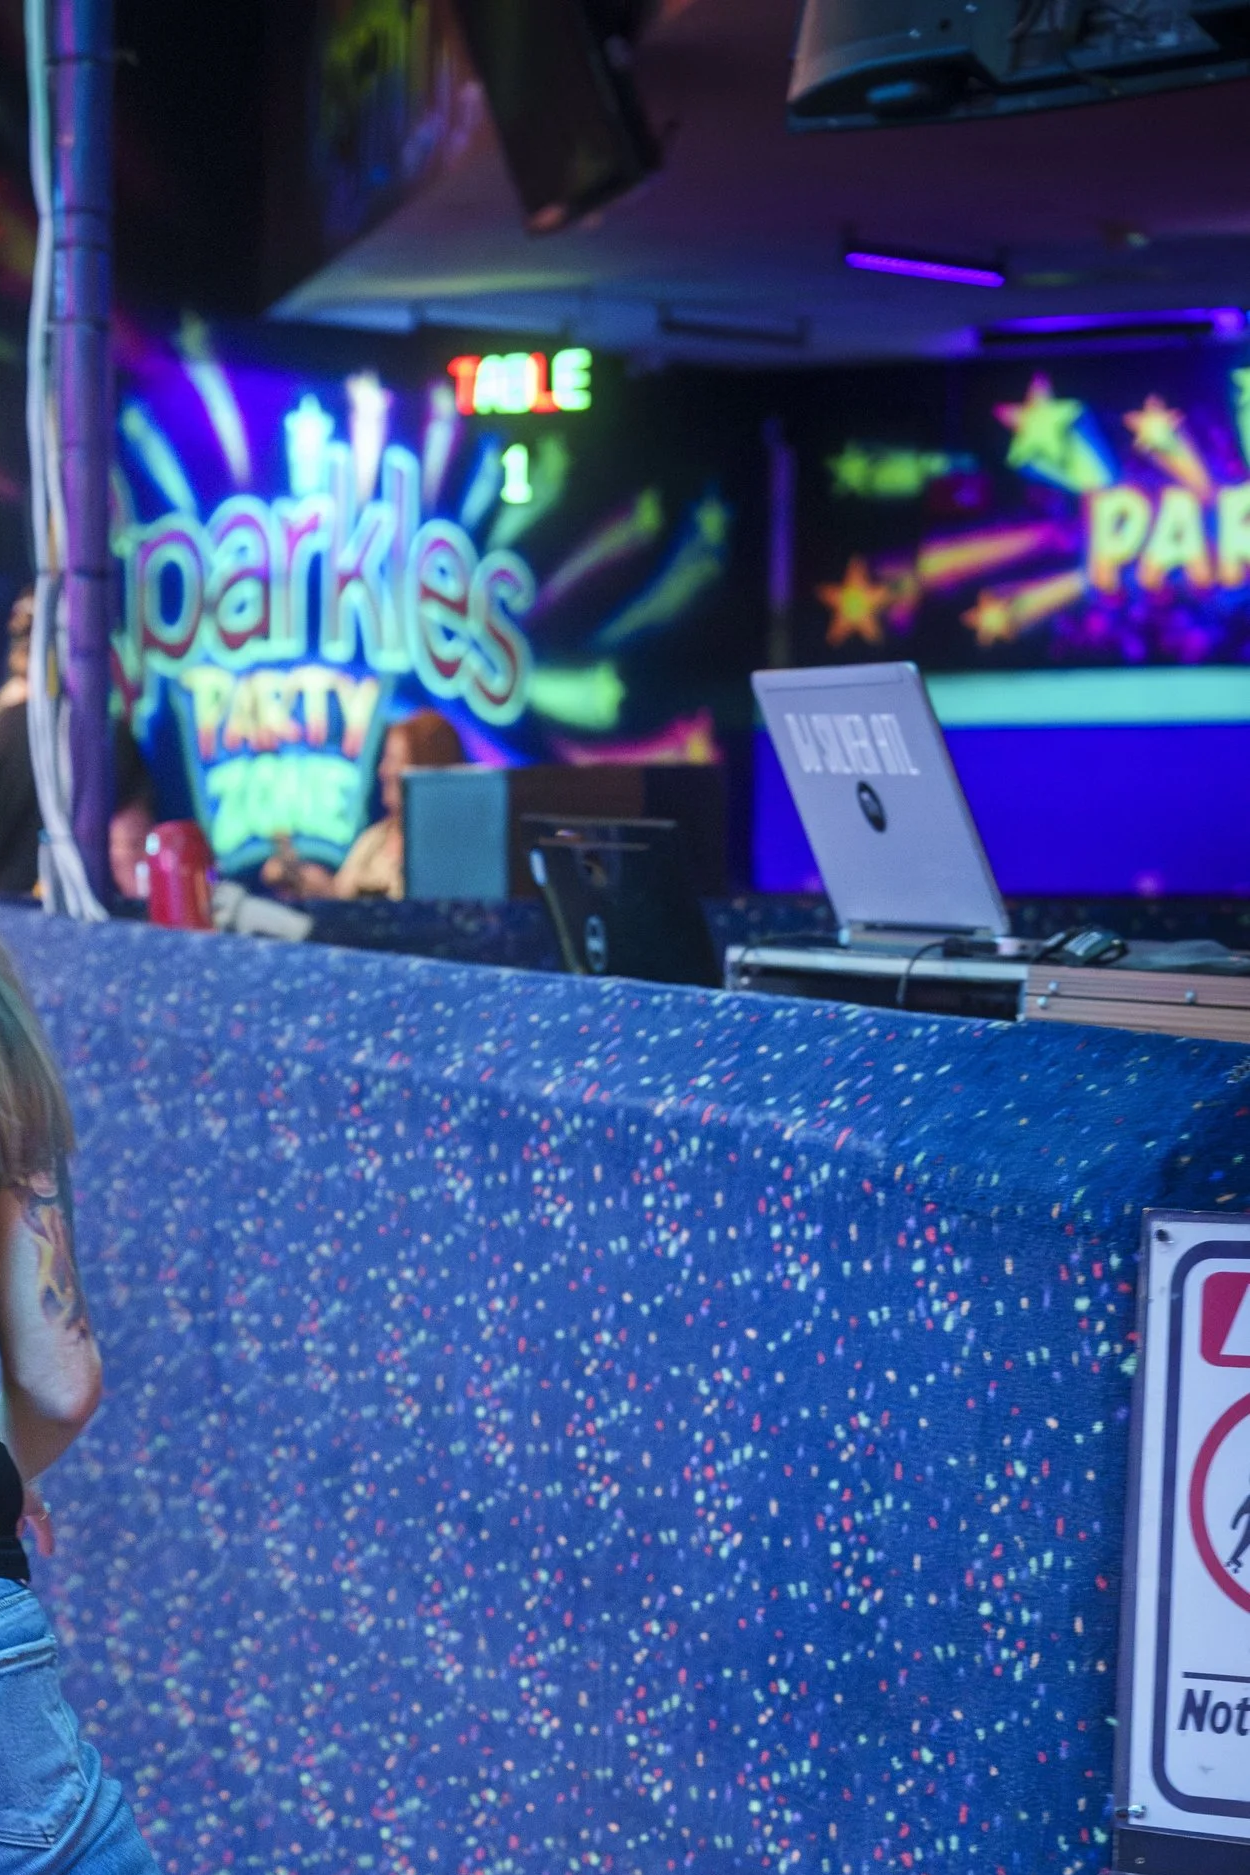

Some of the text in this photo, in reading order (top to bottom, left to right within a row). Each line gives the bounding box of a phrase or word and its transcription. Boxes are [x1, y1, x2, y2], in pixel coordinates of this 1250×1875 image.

[501, 443, 533, 504] 1
[110, 442, 536, 740] parkles
[180, 665, 379, 760] PARTY
